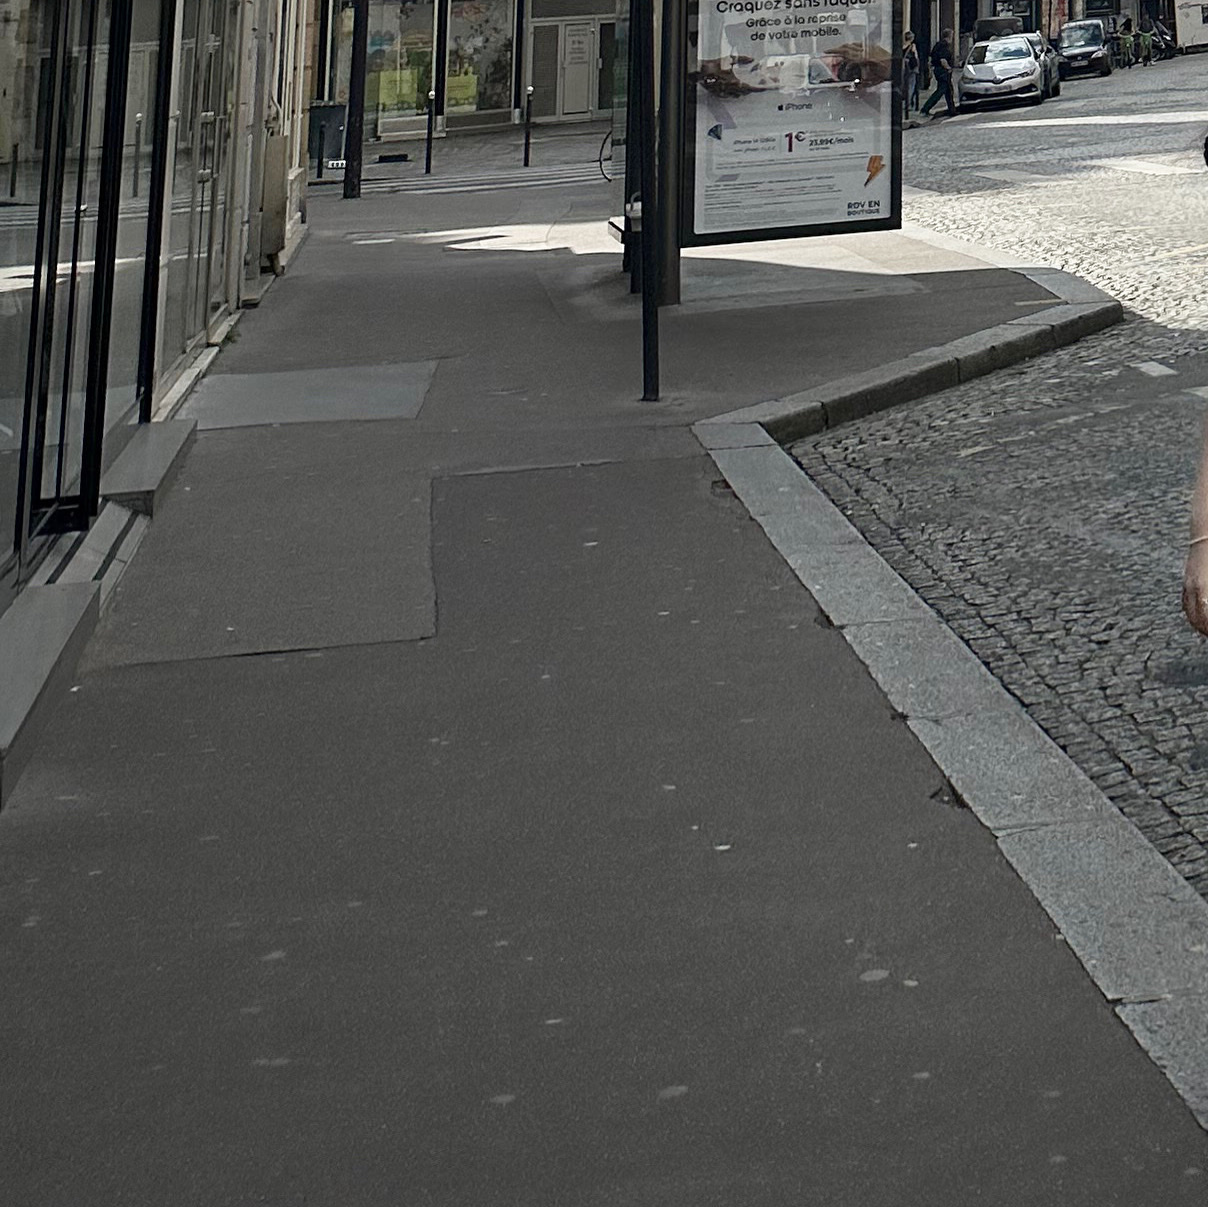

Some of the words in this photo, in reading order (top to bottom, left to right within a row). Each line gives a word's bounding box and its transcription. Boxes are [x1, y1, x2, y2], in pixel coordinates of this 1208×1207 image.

[716, 0, 781, 14] Craquez
[746, 16, 781, 28] Grâce
[784, 15, 792, 25] à
[794, 15, 806, 24] la
[807, 12, 846, 24] reprise
[751, 31, 766, 41] de
[769, 29, 798, 40] votre
